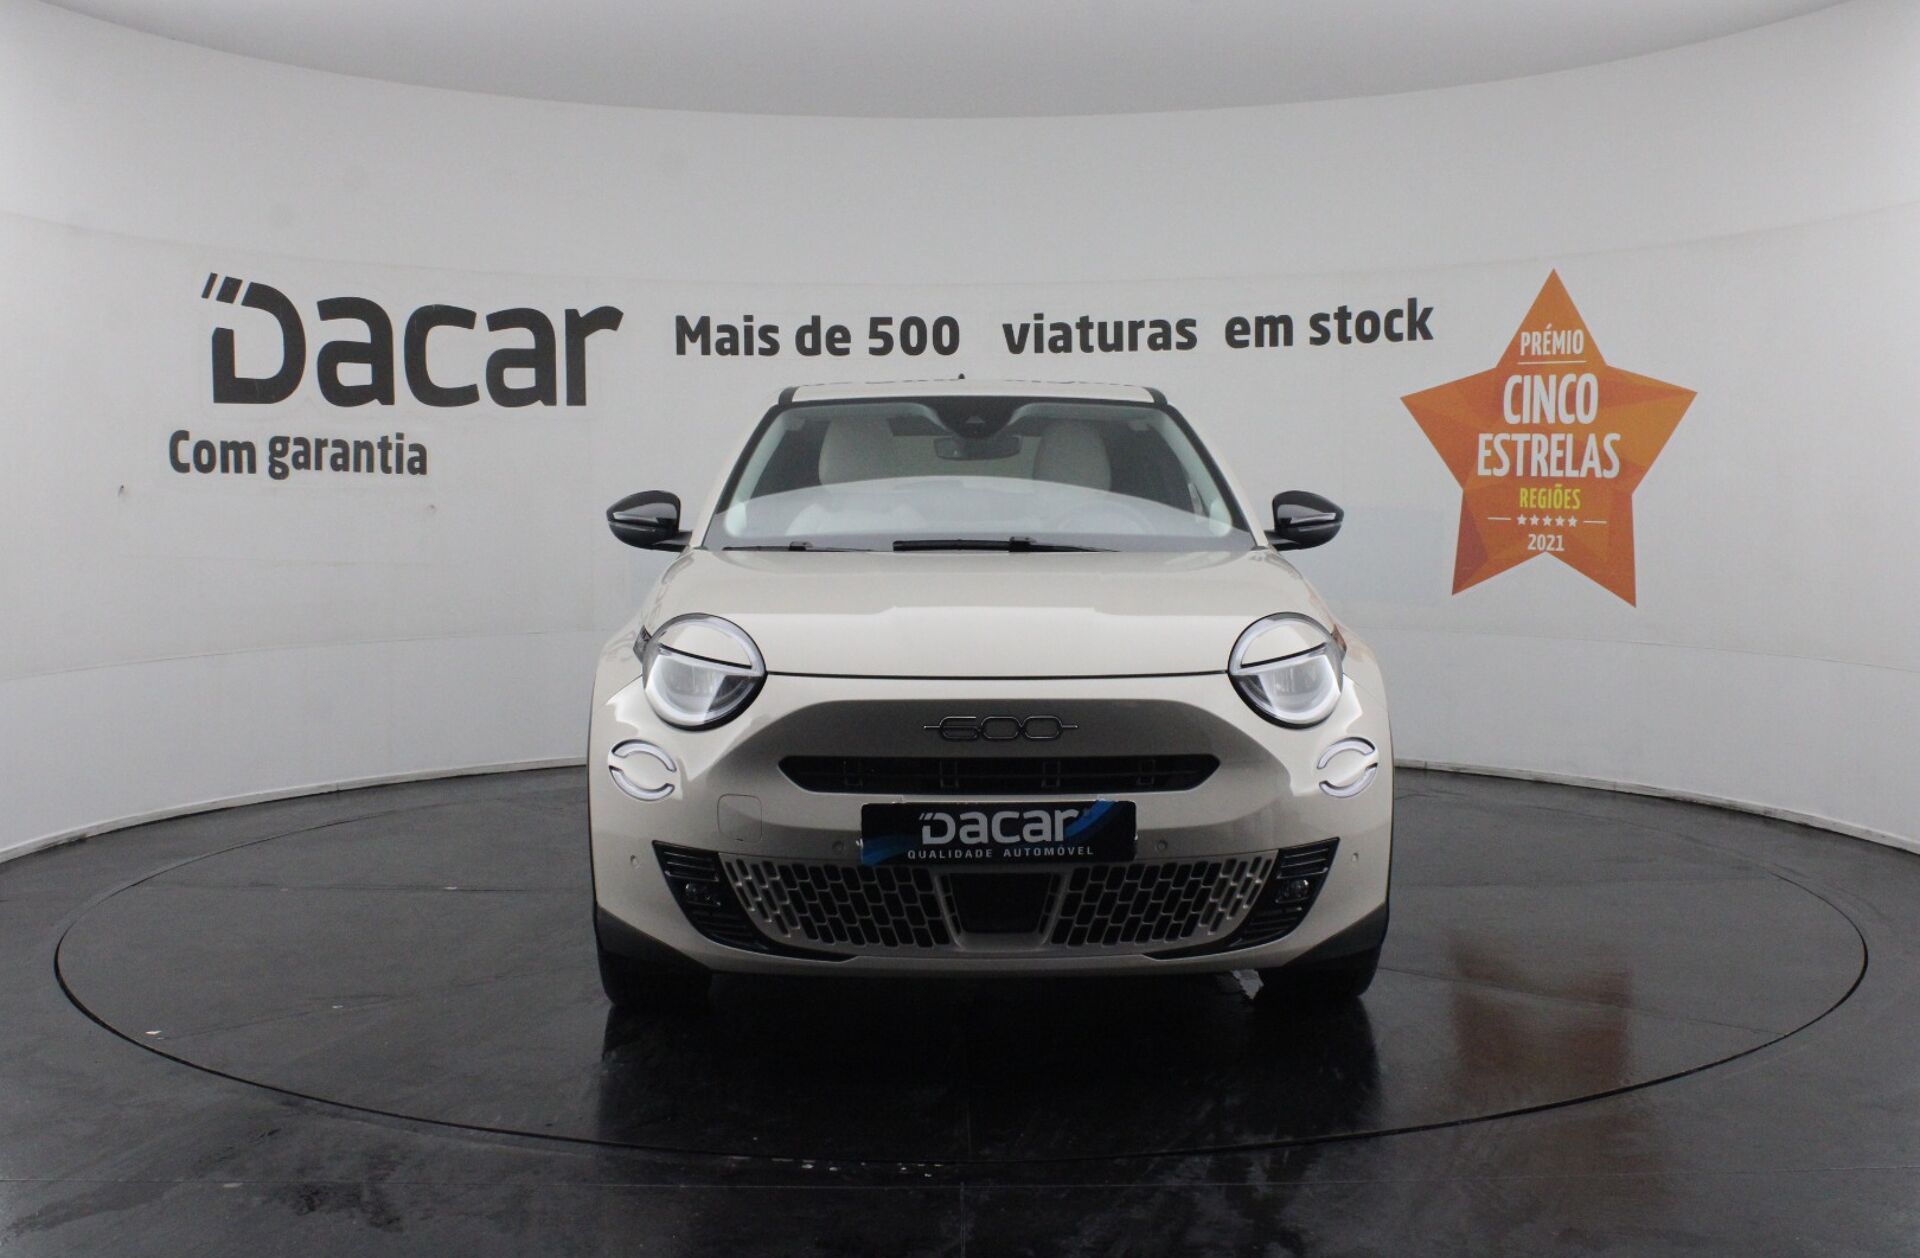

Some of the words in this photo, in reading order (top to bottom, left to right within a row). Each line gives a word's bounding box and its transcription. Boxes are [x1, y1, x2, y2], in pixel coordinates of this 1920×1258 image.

[201, 272, 624, 408] Dacar
[675, 314, 780, 357] Mais
[795, 315, 852, 357] de
[868, 315, 960, 356] 500
[1002, 312, 1198, 355] viaturas
[1225, 314, 1294, 349] em
[1309, 297, 1434, 346] stock
[1520, 323, 1585, 356] PRÉMIO
[1503, 373, 1599, 425] CINCO
[169, 429, 257, 474] Com
[268, 432, 428, 480] garantia
[1477, 432, 1621, 479] ESTRELAS
[1519, 483, 1581, 510] REGIÕES
[1527, 533, 1565, 552] 2021
[922, 715, 1079, 741] 600
[919, 808, 1079, 845] Dacar
[907, 849, 993, 860] QUALIDADE
[1003, 845, 1094, 857] AUTOMÓVEL
